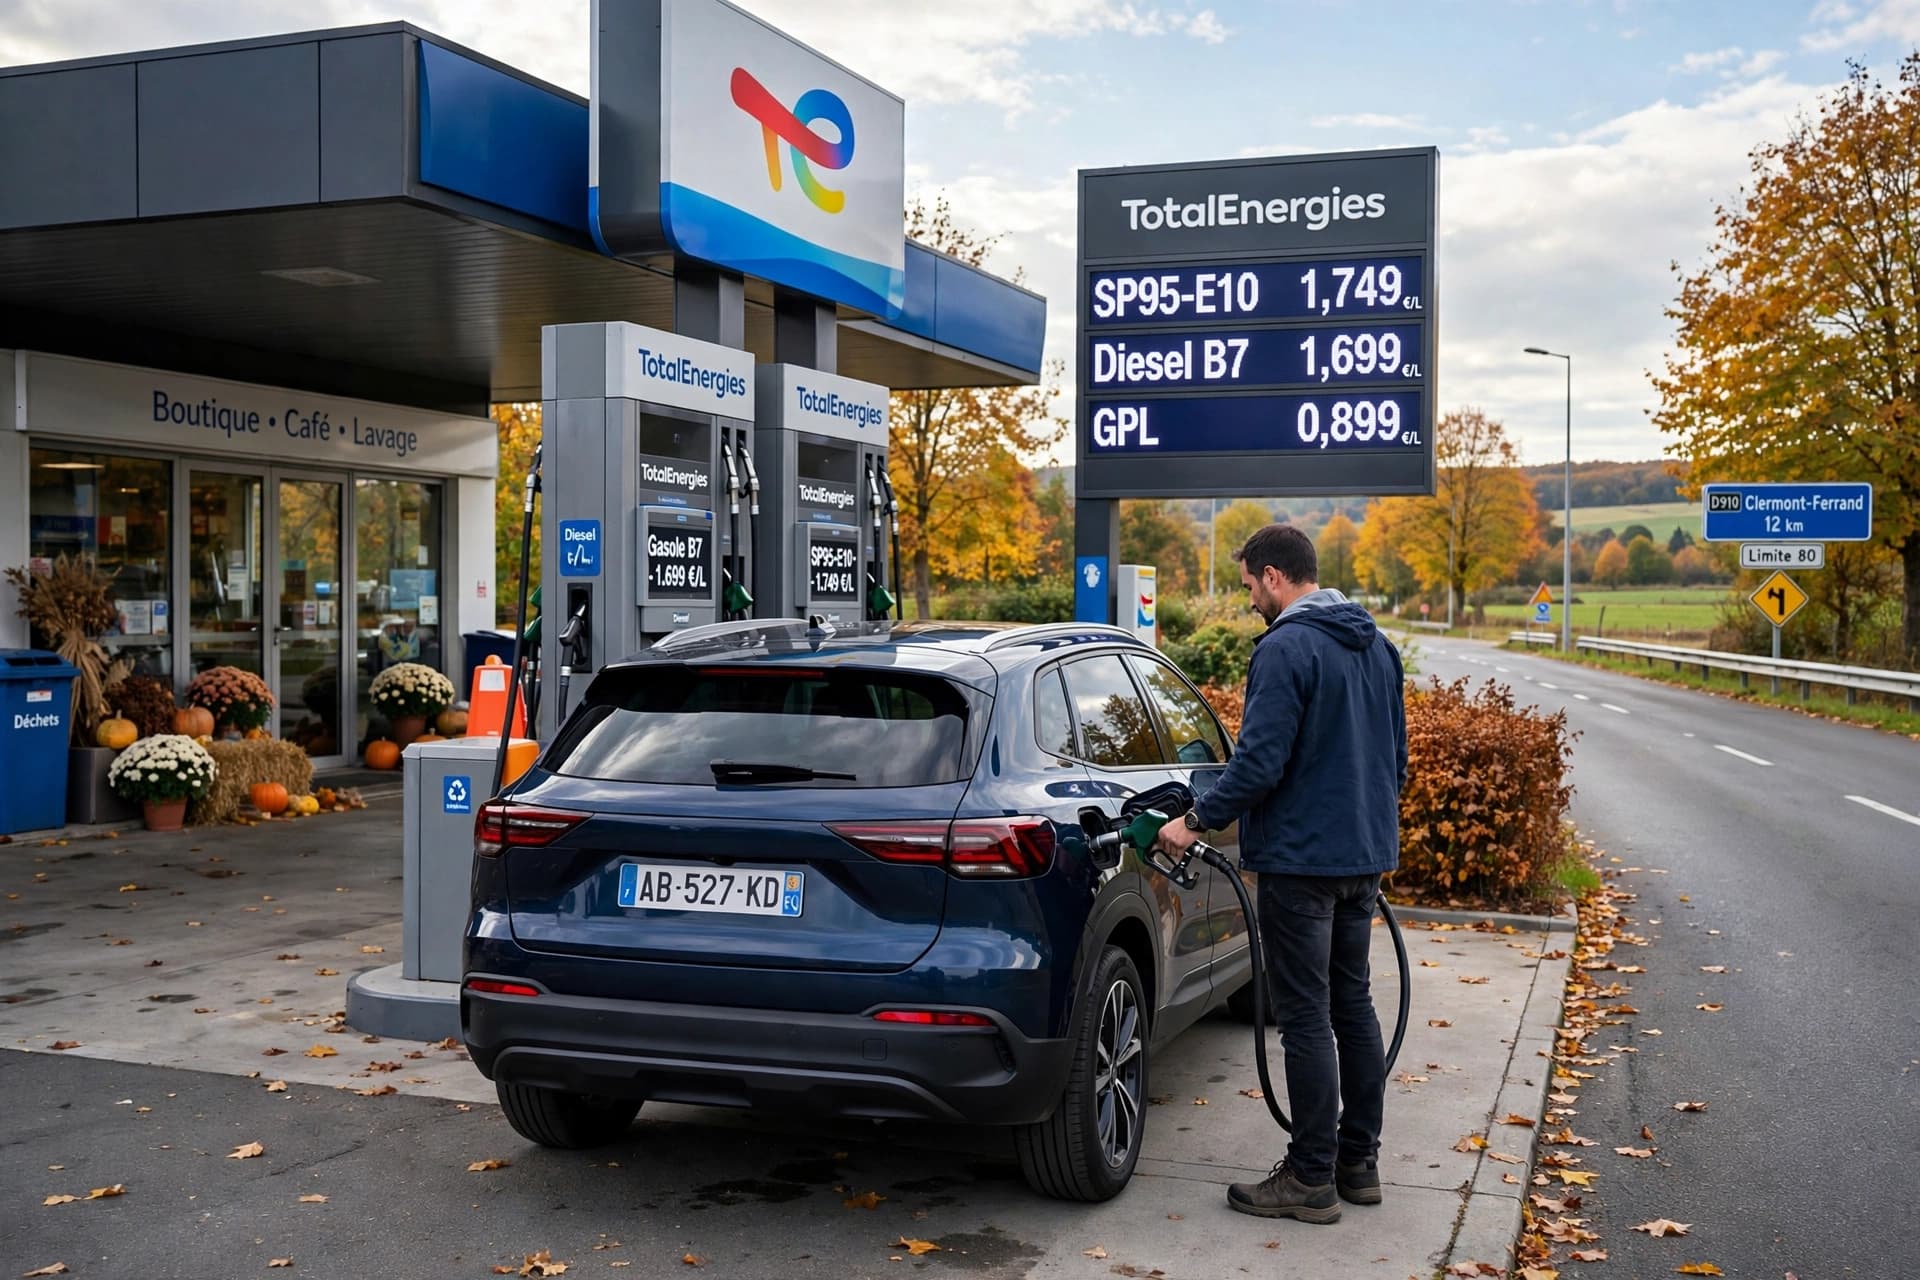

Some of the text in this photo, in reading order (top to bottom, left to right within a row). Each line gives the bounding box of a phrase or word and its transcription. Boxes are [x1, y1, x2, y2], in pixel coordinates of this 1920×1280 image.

[1122, 187, 1386, 231] TotalEnergies
[1094, 271, 1259, 317] SP95-E10
[1301, 265, 1401, 315] 1,749
[1094, 340, 1192, 382] Diesel
[1204, 338, 1249, 379] B7
[1300, 333, 1401, 383] 1,699
[638, 348, 746, 398] TotalEnergies
[796, 386, 882, 428] TotalEnergies
[152, 390, 418, 457] Boutique Café Lavage
[1094, 407, 1159, 446] GPL
[1297, 400, 1400, 449] 0,899
[641, 463, 708, 490] TotalEnergies
[799, 484, 855, 508] TotalEnergies
[1711, 494, 1864, 511] D910 Clermont-Ferrand
[566, 528, 596, 541] Diesel
[1764, 515, 1804, 533] 12 km
[648, 534, 685, 558] Gasole
[688, 536, 703, 558] B7
[1749, 548, 1816, 563] Limite 80
[688, 565, 707, 588] €/L
[14, 713, 60, 729] Déchets
[639, 871, 780, 909] AB-527-KD
